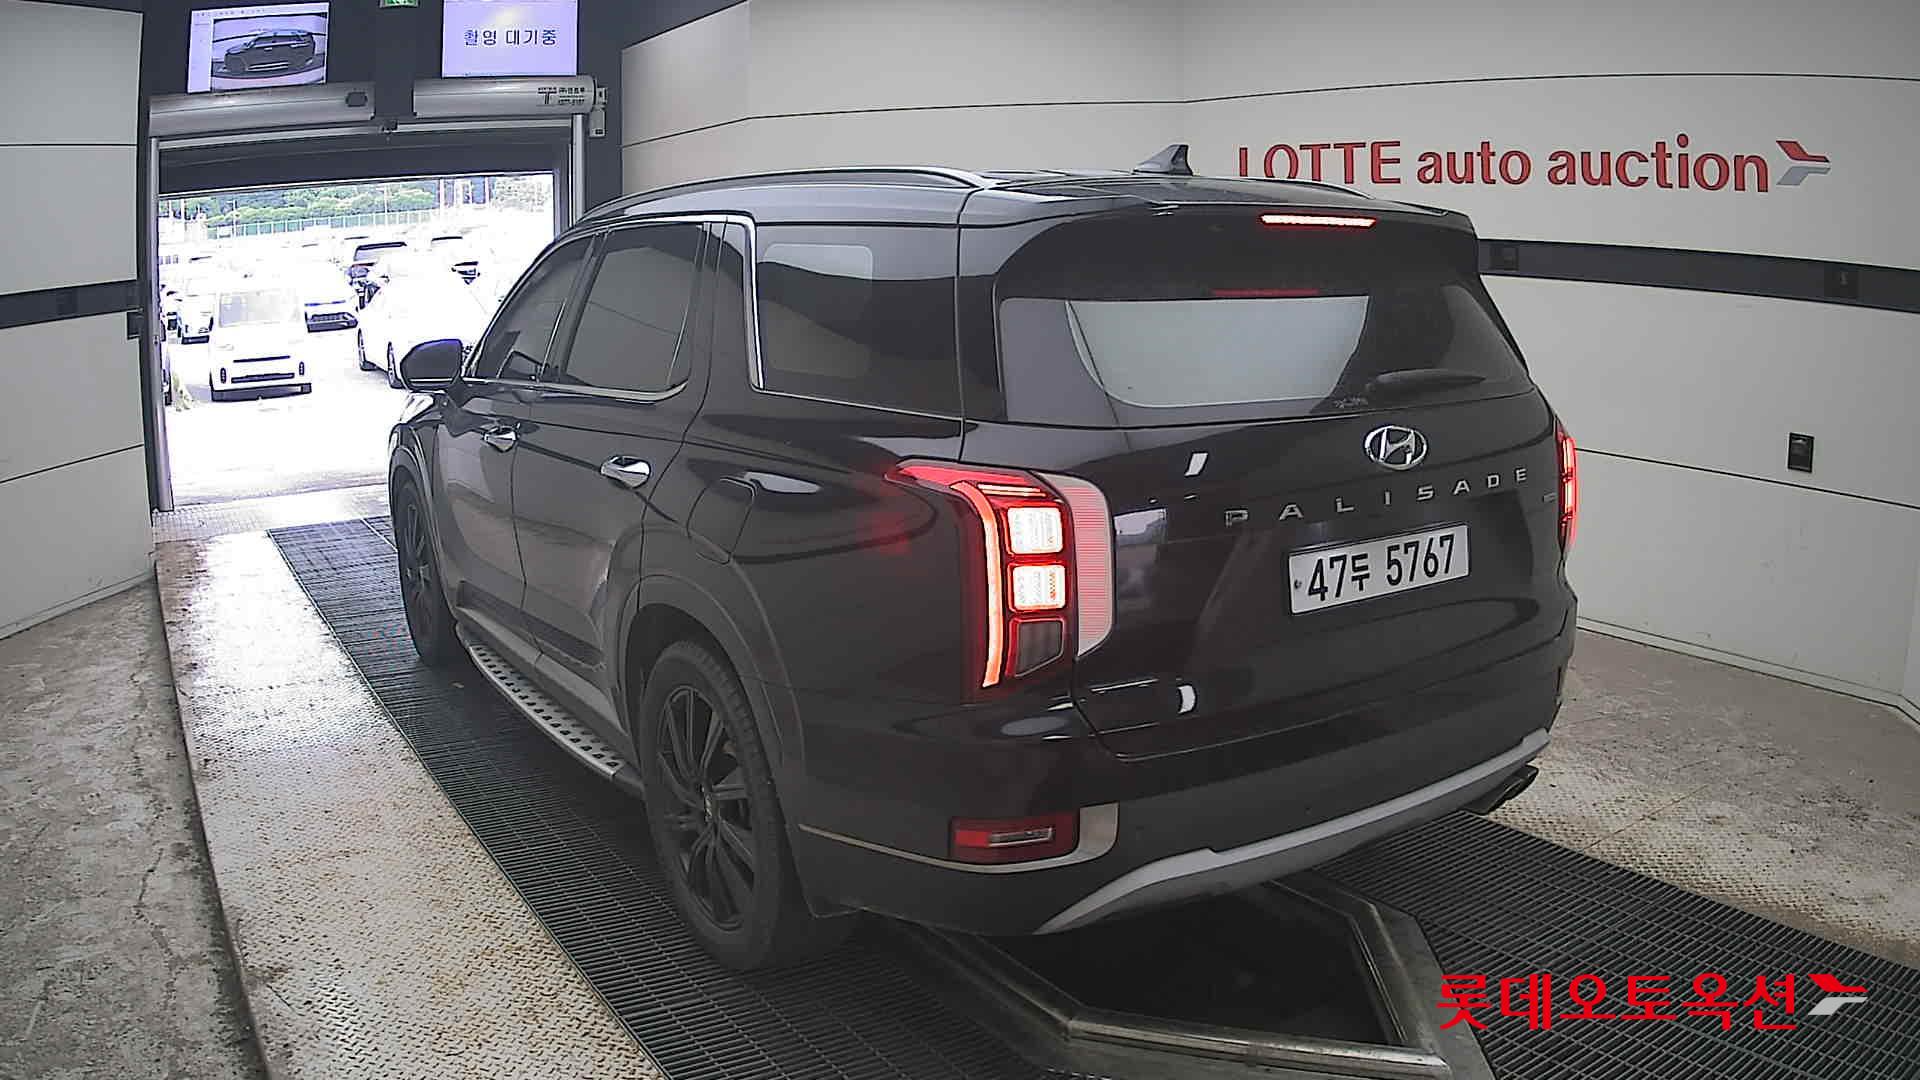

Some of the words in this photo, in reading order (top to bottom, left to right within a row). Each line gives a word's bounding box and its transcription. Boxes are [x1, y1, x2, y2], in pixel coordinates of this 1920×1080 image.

[505, 29, 556, 46] 대기중
[1416, 141, 1532, 185] auto
[1548, 134, 1768, 192] auction
[1225, 468, 1528, 527] PALISADE
[1308, 554, 1370, 601] 47두
[1386, 534, 1454, 586] 5767
